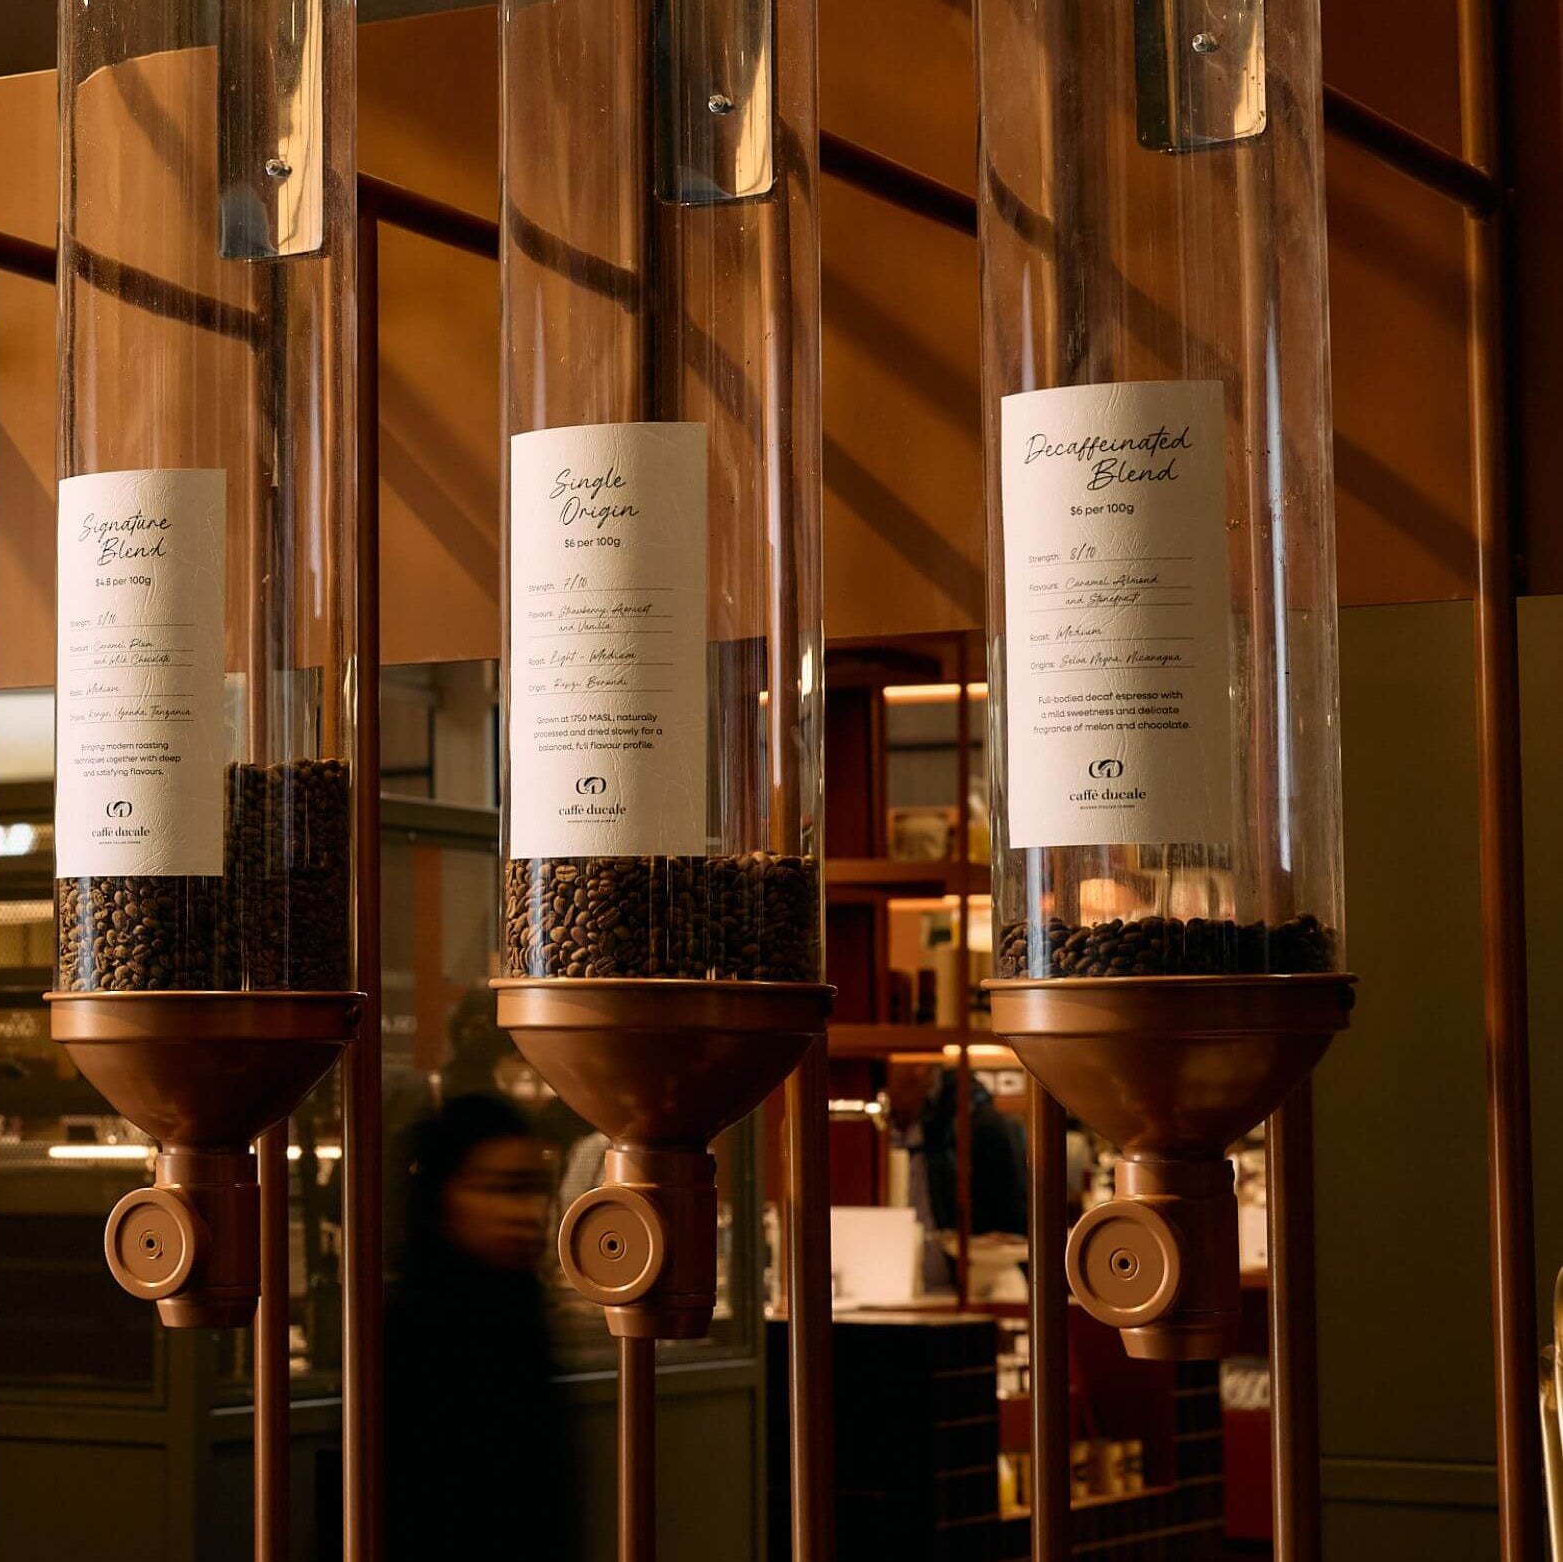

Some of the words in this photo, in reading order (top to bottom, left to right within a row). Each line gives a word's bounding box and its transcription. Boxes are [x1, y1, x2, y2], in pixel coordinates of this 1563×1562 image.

[1024, 425, 1192, 464] Decaffeinated
[1087, 457, 1180, 491] Blend
[549, 467, 627, 500] Single
[559, 496, 640, 529] Origin
[1070, 505, 1083, 516] $6
[1085, 506, 1105, 515] per
[1107, 502, 1134, 515] 100g
[78, 509, 173, 542] Signature
[564, 538, 576, 548] $6
[577, 539, 593, 548] per
[596, 537, 621, 548] 100g
[97, 537, 166, 566] Blend
[1069, 542, 1096, 561] 8/10
[112, 577, 128, 587] per
[129, 575, 152, 587] 100g
[1065, 596, 1085, 606] and
[1056, 625, 1103, 640] Medium
[550, 650, 577, 666] Light
[589, 648, 637, 663] Medium
[1126, 651, 1182, 665] Nicaragua
[1085, 692, 1113, 702] decaf
[1115, 691, 1159, 701] espresso
[1160, 691, 1184, 700] with
[1048, 710, 1065, 719] mild
[1067, 708, 1114, 717] sweetness
[1116, 707, 1136, 715] and
[1138, 706, 1180, 715] delicate
[536, 717, 560, 725] Grown
[560, 716, 569, 724] at
[616, 713, 658, 723] naturally
[533, 729, 569, 739] processed
[570, 728, 586, 737] and
[587, 728, 610, 736] dried
[611, 727, 639, 737] slowly
[641, 727, 655, 735] for
[1033, 725, 1072, 735] fragrance
[1073, 723, 1084, 732] of
[1085, 723, 1114, 731] melon
[1116, 721, 1136, 730] and
[1138, 721, 1191, 730] chocolate.
[135, 741, 169, 751] roasting
[575, 742, 589, 751] full
[590, 741, 621, 750] flavour
[622, 741, 655, 751] profile.
[106, 755, 138, 765] together
[139, 754, 158, 762] with
[159, 754, 181, 764] deep
[130, 768, 164, 776] flavours.
[1101, 788, 1147, 800] ducale
[586, 803, 627, 815] ducale
[115, 826, 151, 837] ducale
